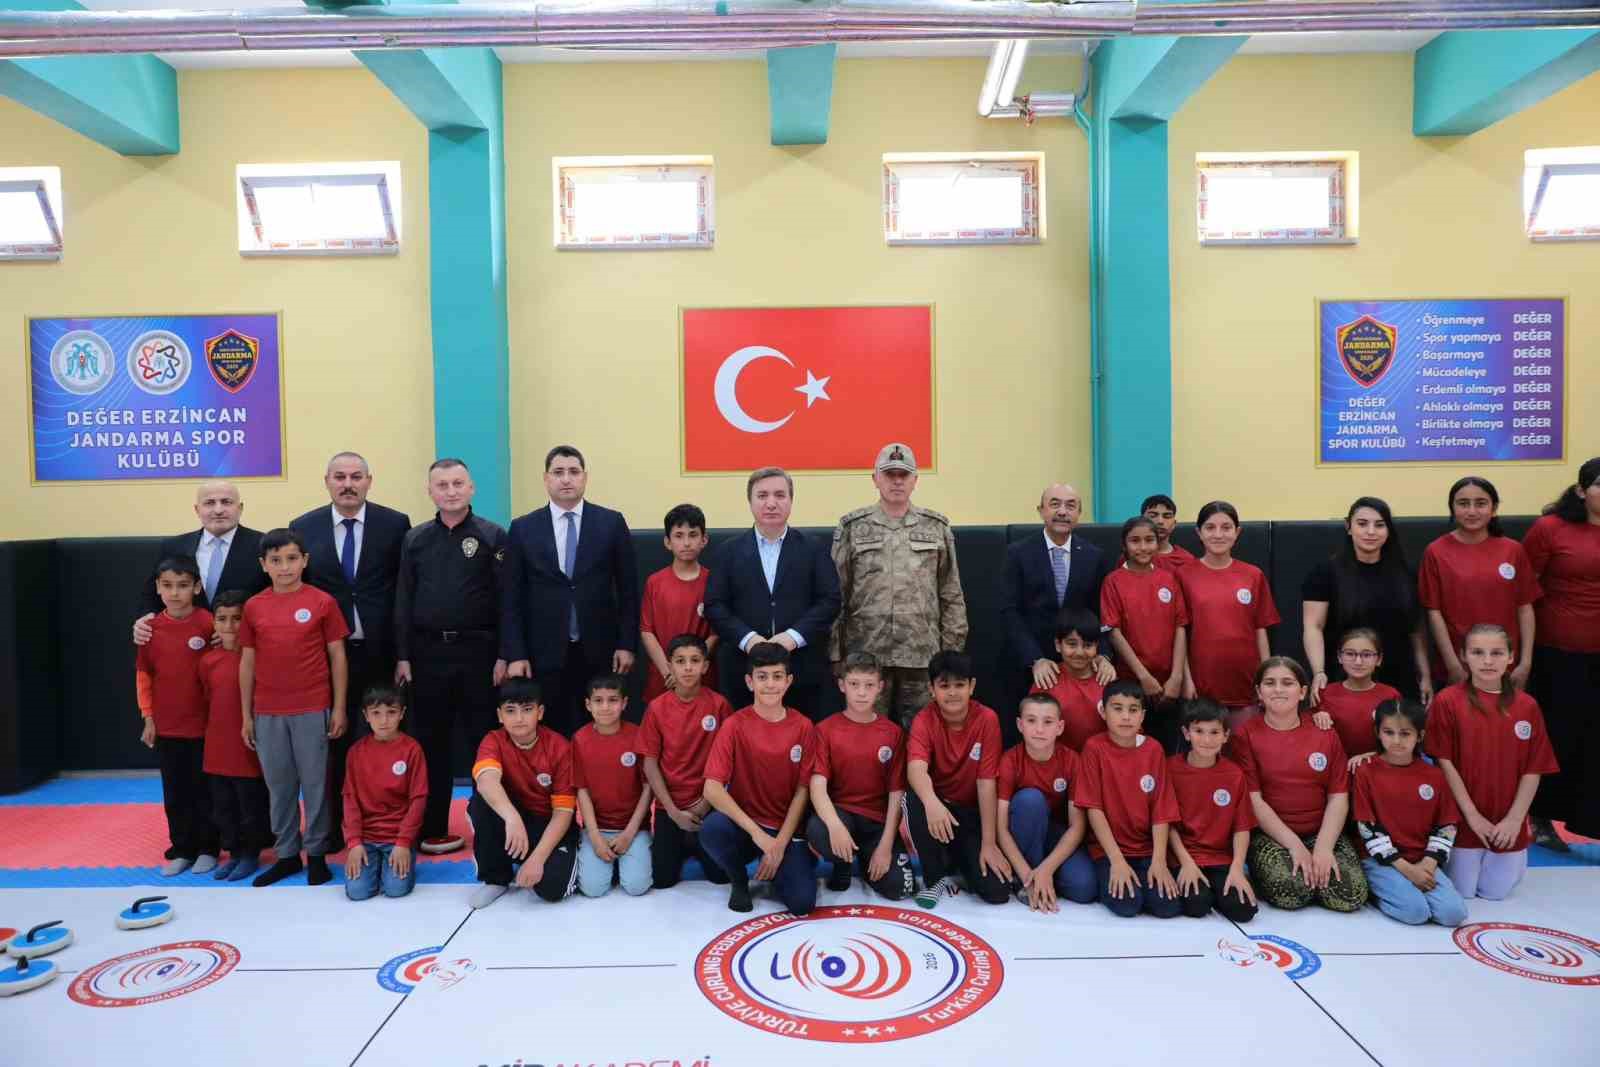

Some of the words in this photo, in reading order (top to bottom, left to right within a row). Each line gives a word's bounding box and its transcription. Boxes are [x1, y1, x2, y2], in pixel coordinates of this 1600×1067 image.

[1423, 312, 1485, 327] Öğrenmeye
[1513, 312, 1552, 324] DEĞER
[1423, 332, 1448, 344] Spor
[1450, 334, 1502, 344] yapmaya
[1513, 329, 1552, 341] DEĞER
[1343, 341, 1391, 349] JANDARMA
[211, 351, 252, 360] JANDARMA
[1423, 350, 1484, 361] Başarmaya
[1513, 346, 1552, 358] DEĞER
[1422, 367, 1487, 379] Mücadeleye
[1513, 364, 1552, 376] DEĞER
[1422, 384, 1464, 394] Erdemli
[1465, 385, 1506, 396] olmaya
[1513, 381, 1552, 393] DEĞER
[1349, 396, 1385, 408] DEĞER
[1422, 402, 1460, 412] Ahlaklı
[1462, 402, 1504, 414] olmaya
[1513, 398, 1552, 410] DEĞER
[67, 408, 135, 426] DEĞER
[142, 406, 247, 425] ERZİNCAN
[1338, 410, 1396, 421] ERZİNCAN
[1336, 425, 1399, 435] JANDARMA
[1422, 419, 1460, 428] Birlikte
[1462, 420, 1504, 431] olmaya
[1513, 416, 1552, 428] DEĞER
[70, 431, 185, 448] JANDARMA
[191, 430, 246, 445] SPOR
[1328, 439, 1358, 449] SPOR
[1361, 437, 1406, 449] KULÜBÜ
[1422, 437, 1486, 448] Keşfetmeye
[1513, 433, 1552, 445] DEĞER
[117, 450, 200, 469] KULÜBÜ
[898, 911, 981, 954] Federation
[923, 952, 938, 970] 2016
[969, 948, 991, 986] Curling
[703, 952, 736, 1001] CURLING
[918, 983, 985, 1024] Turkish
[725, 999, 809, 1036] TÜRKİYE
